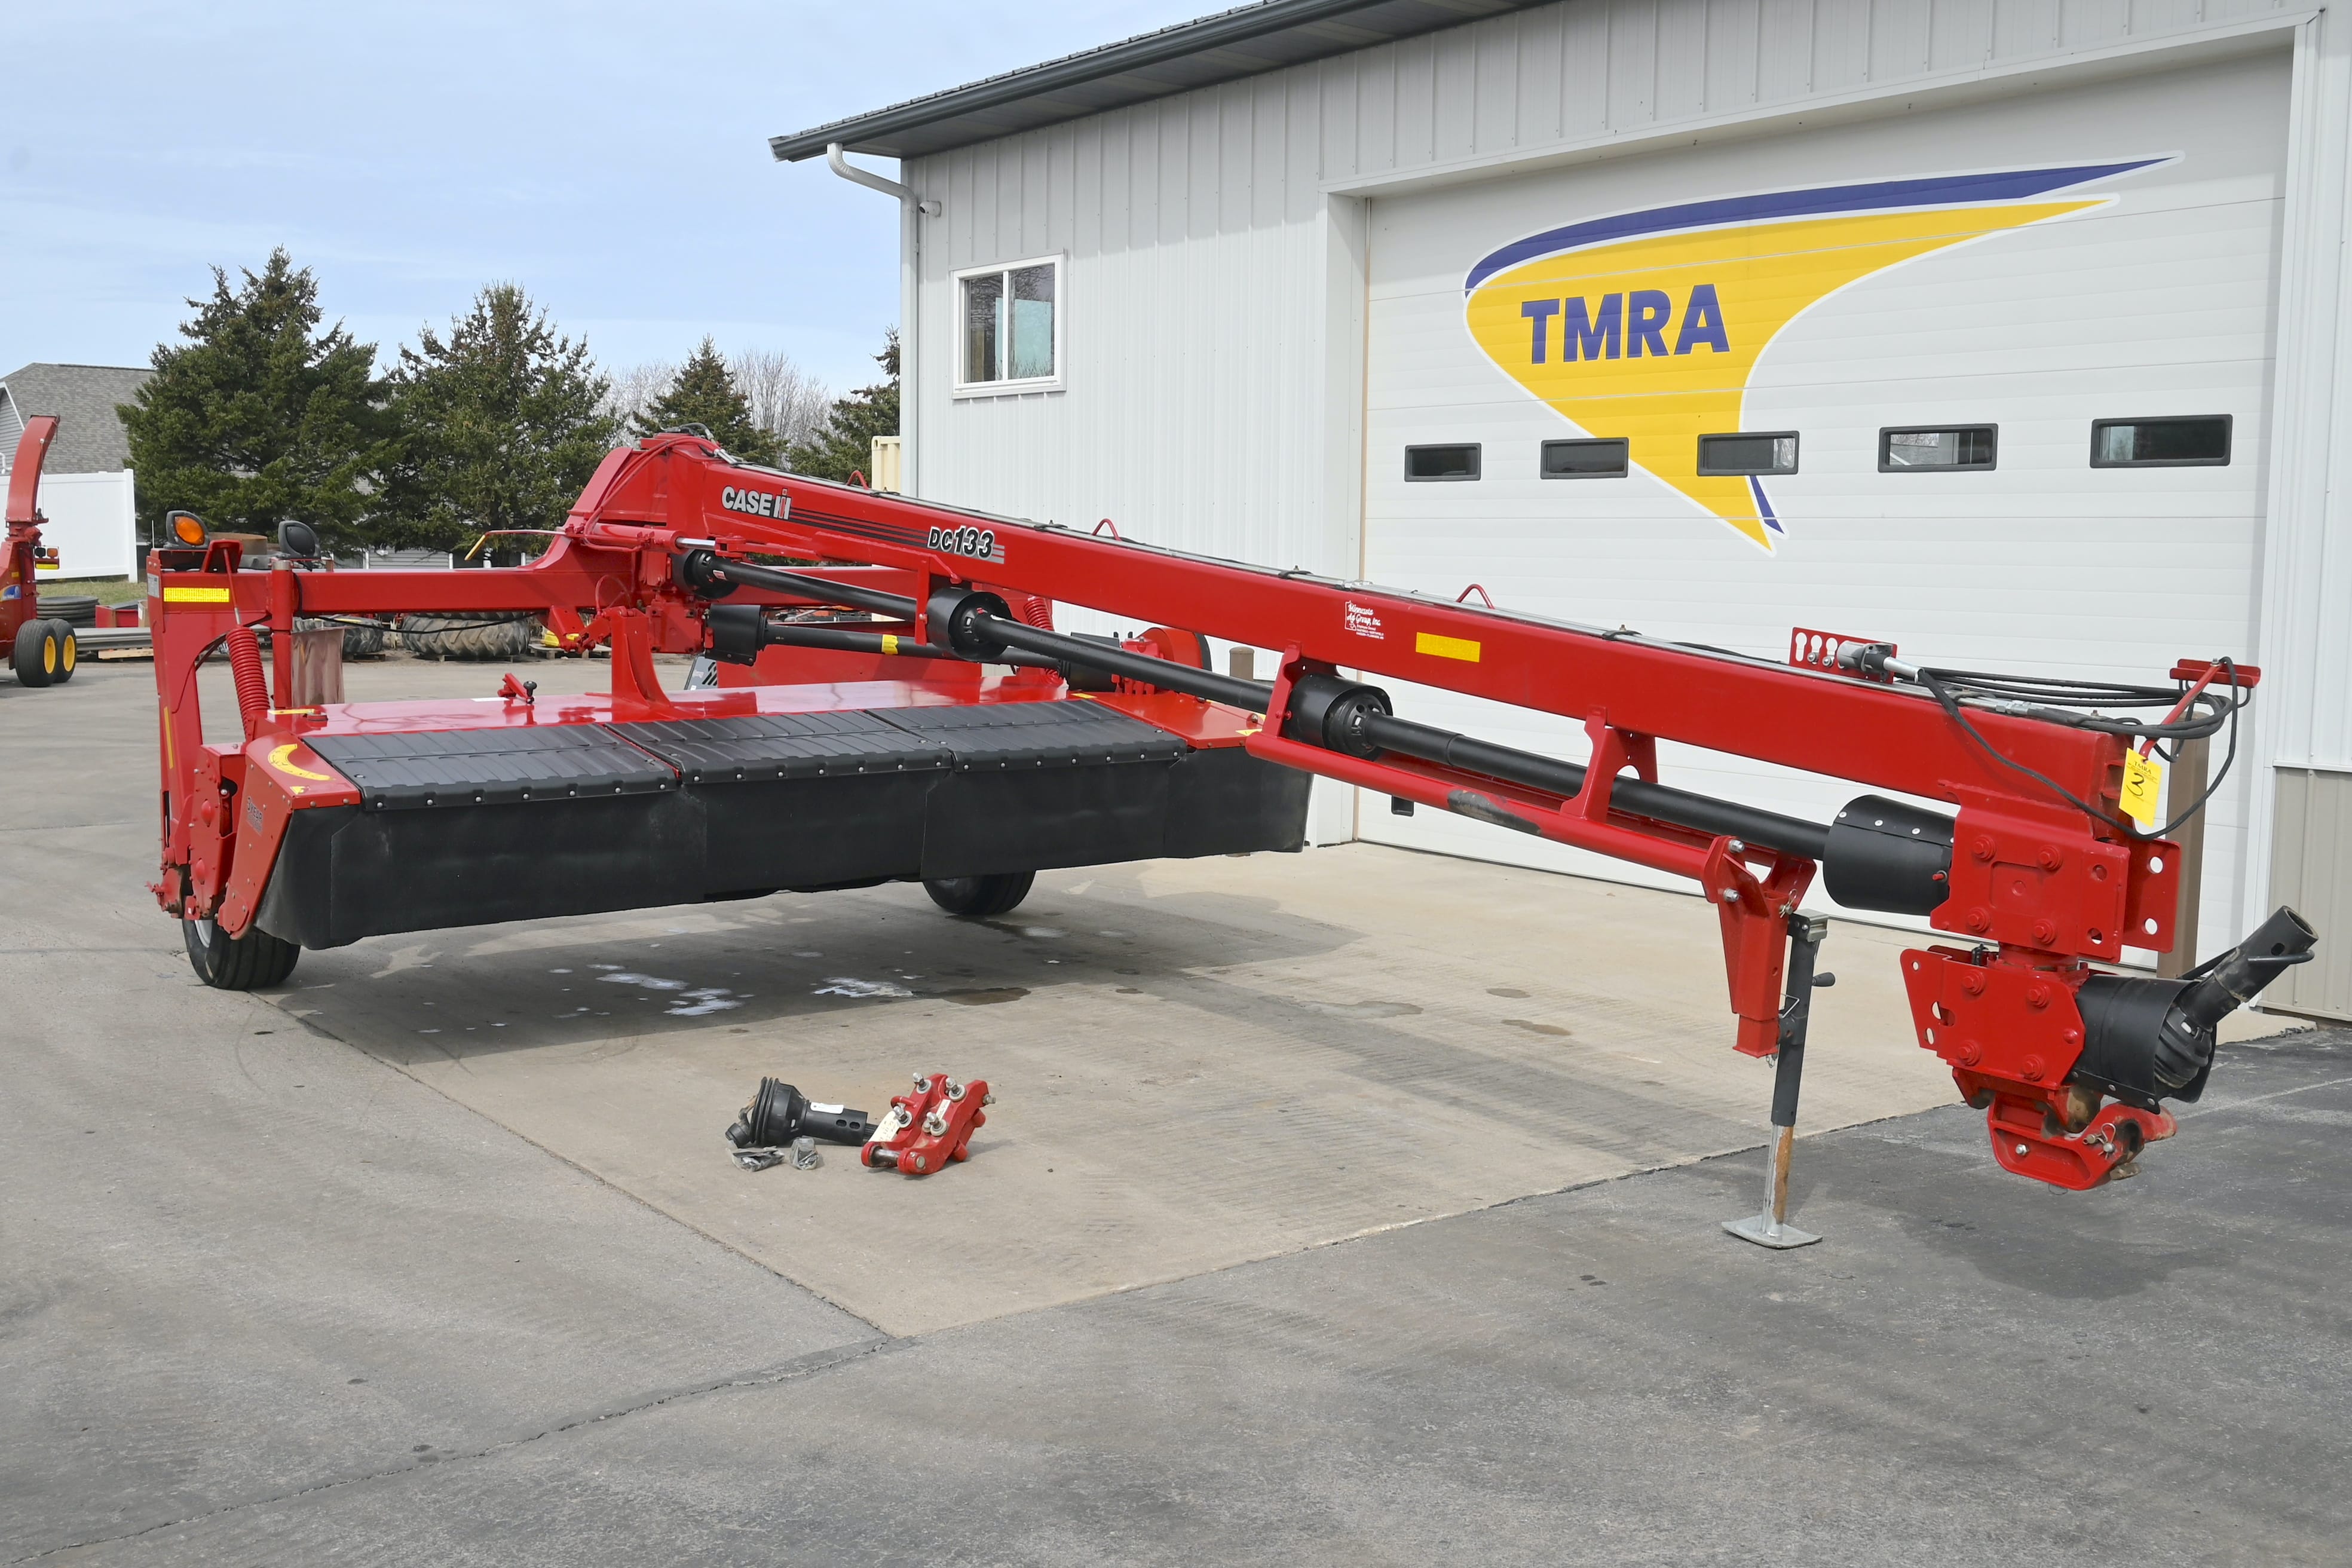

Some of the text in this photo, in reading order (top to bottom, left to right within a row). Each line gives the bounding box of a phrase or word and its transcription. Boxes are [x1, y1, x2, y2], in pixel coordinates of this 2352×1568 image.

[1521, 283, 1731, 365] TMRA
[721, 486, 773, 516] CASE
[927, 525, 994, 561] DC133
[1348, 604, 1374, 615] Minnesota
[2134, 761, 2152, 774] TMRA
[2126, 772, 2145, 797] 3
